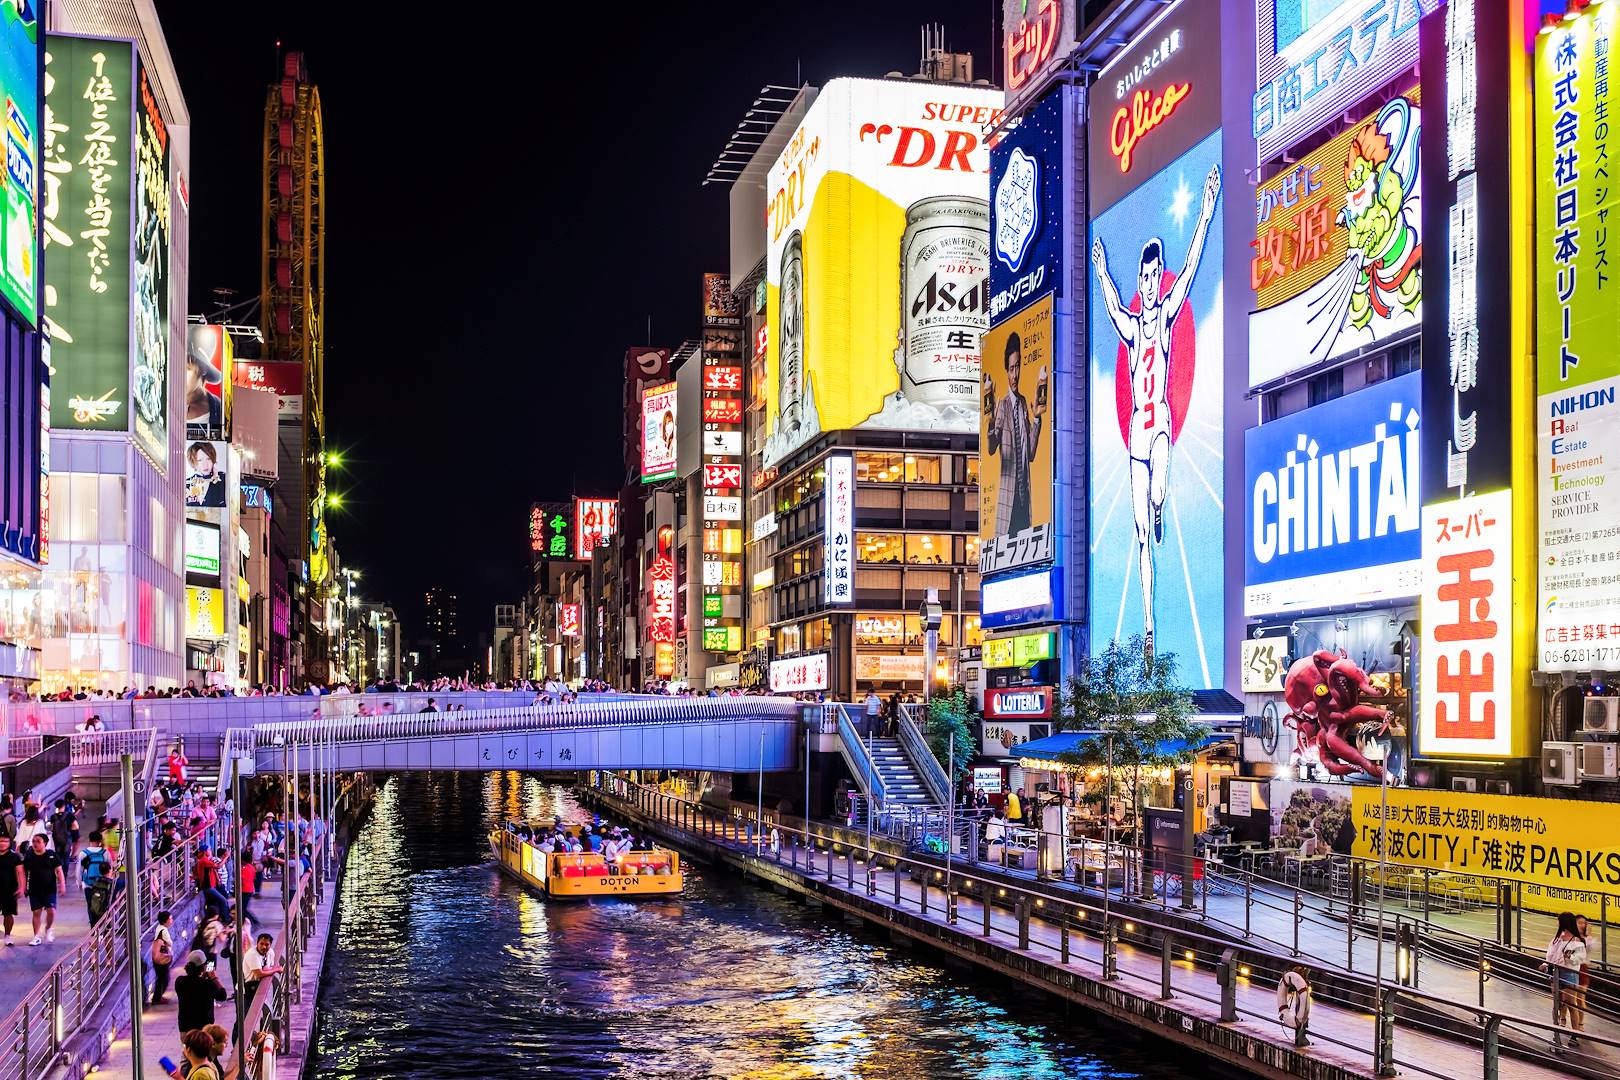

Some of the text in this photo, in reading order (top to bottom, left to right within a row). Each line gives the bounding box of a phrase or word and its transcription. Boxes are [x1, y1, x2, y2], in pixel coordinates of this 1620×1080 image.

[79, 52, 118, 294] 1位と2位を当てたら
[1257, 163, 1322, 225] かぜに
[1554, 34, 1580, 380] 株式会社日本リート
[1249, 197, 1329, 293] 改源
[946, 330, 975, 350] 生
[705, 358, 719, 366] 8F
[948, 383, 973, 395] 350ml
[1143, 339, 1157, 430] グリコ
[705, 390, 719, 398] 7F
[1551, 386, 1615, 418] NIHON
[705, 423, 719, 431] 6F
[1551, 418, 1579, 437] Real
[1551, 437, 1588, 456] Estate
[1551, 455, 1603, 474] Investment
[1253, 400, 1420, 564] CHINTAI
[1550, 474, 1606, 492] Technology
[705, 488, 718, 496] 4F
[1551, 490, 1591, 507] SERVICE
[706, 500, 738, 514] 白木屋
[1551, 502, 1599, 519] PROVIDER
[1436, 508, 1497, 544] スーパー
[705, 586, 718, 594] 1F
[1545, 623, 1620, 643] 広告主募集中
[1433, 548, 1498, 740] 玉出
[1544, 646, 1620, 664] 06-6281-1717
[1002, 694, 1041, 711] LOTTERIA
[482, 747, 572, 761] えびす橋
[600, 877, 640, 886] DOTON
